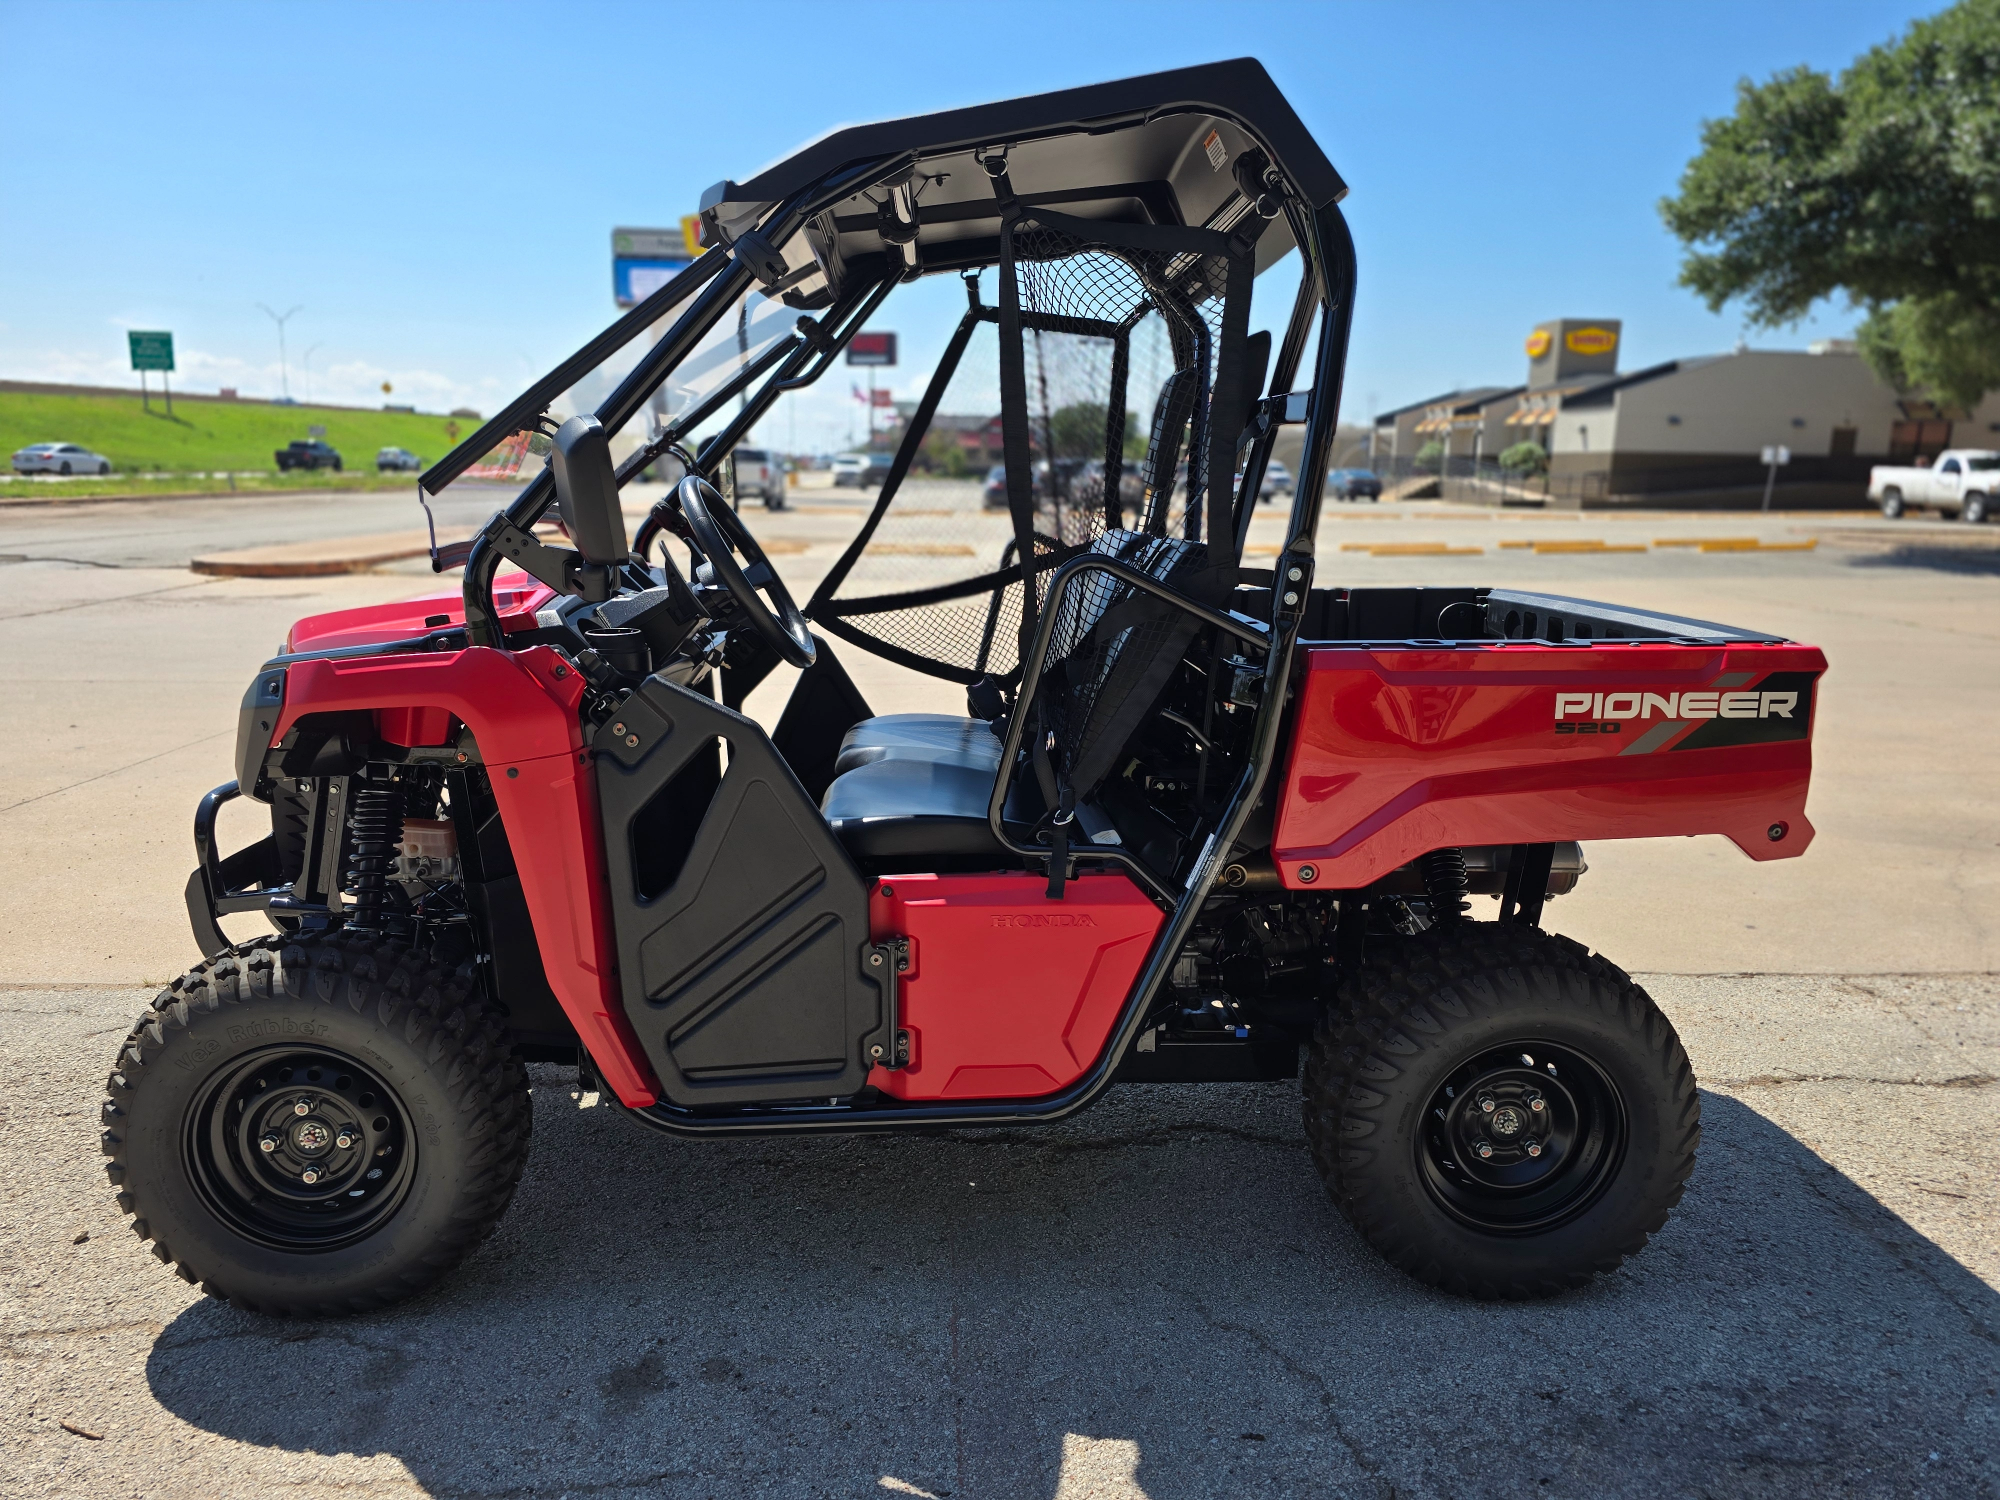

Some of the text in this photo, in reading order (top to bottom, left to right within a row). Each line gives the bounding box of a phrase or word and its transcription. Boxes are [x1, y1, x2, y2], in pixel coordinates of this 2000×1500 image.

[1554, 691, 1798, 720] PIONEER
[1554, 722, 1621, 735] 520
[990, 914, 1098, 928] HONDA
[174, 1017, 329, 1071] Vee Rubber
[413, 1093, 441, 1146] V-392
